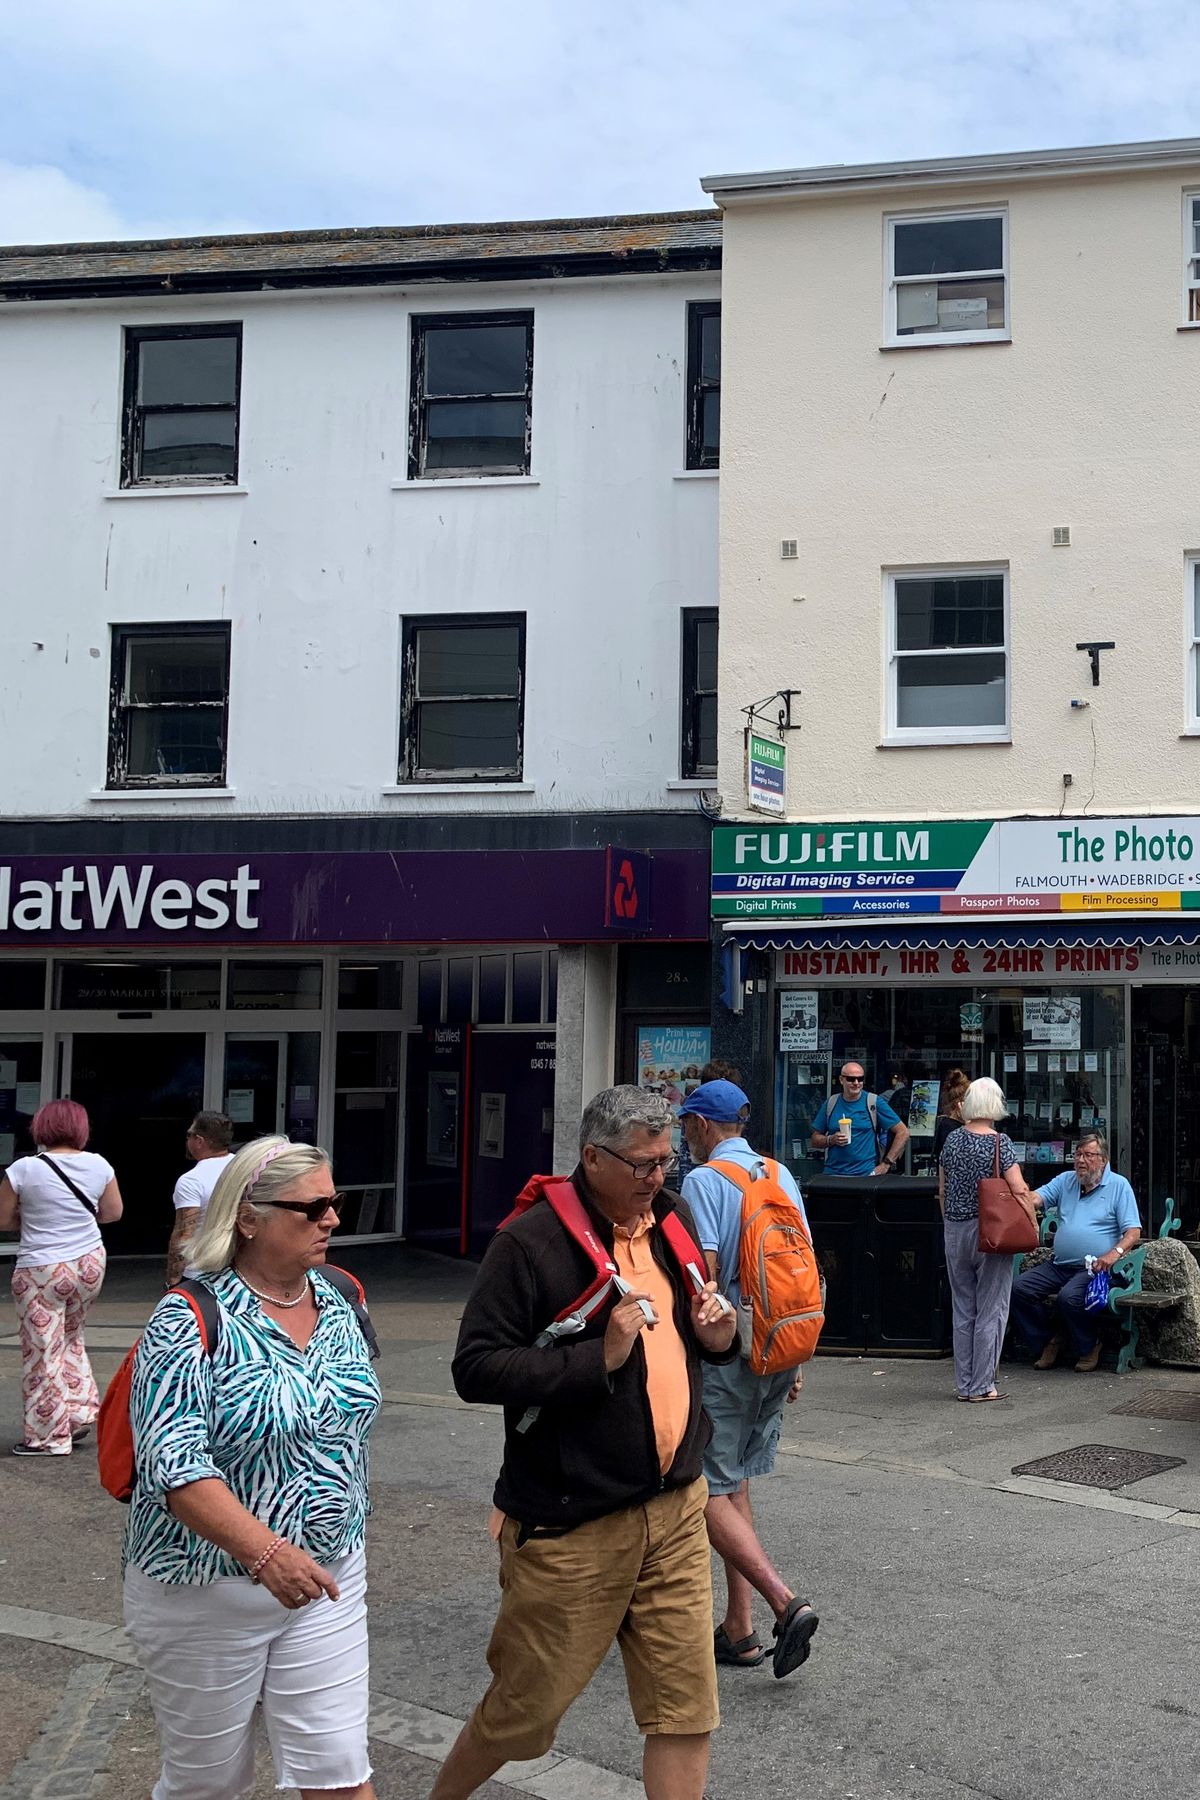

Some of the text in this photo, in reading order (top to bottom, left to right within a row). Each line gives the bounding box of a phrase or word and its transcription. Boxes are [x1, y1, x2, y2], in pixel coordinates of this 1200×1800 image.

[734, 831, 930, 864] FUJIFILM
[1058, 826, 1105, 863] The
[1114, 825, 1194, 862] Photo
[737, 873, 915, 890] Digital Imaging Service
[1015, 875, 1088, 888] FALMOUTH
[1097, 873, 1185, 886] WADEBRIDGE
[0, 864, 260, 931] atWest
[853, 899, 910, 910] Accessories
[960, 896, 1041, 910] Passport Photos
[1082, 894, 1159, 907] Film Processing
[736, 899, 797, 912] Digital Prints
[784, 947, 1138, 976] INSTANT, 1HR & 24HR PRINTS
[1151, 951, 1171, 966] The
[666, 1027, 684, 1038] Print
